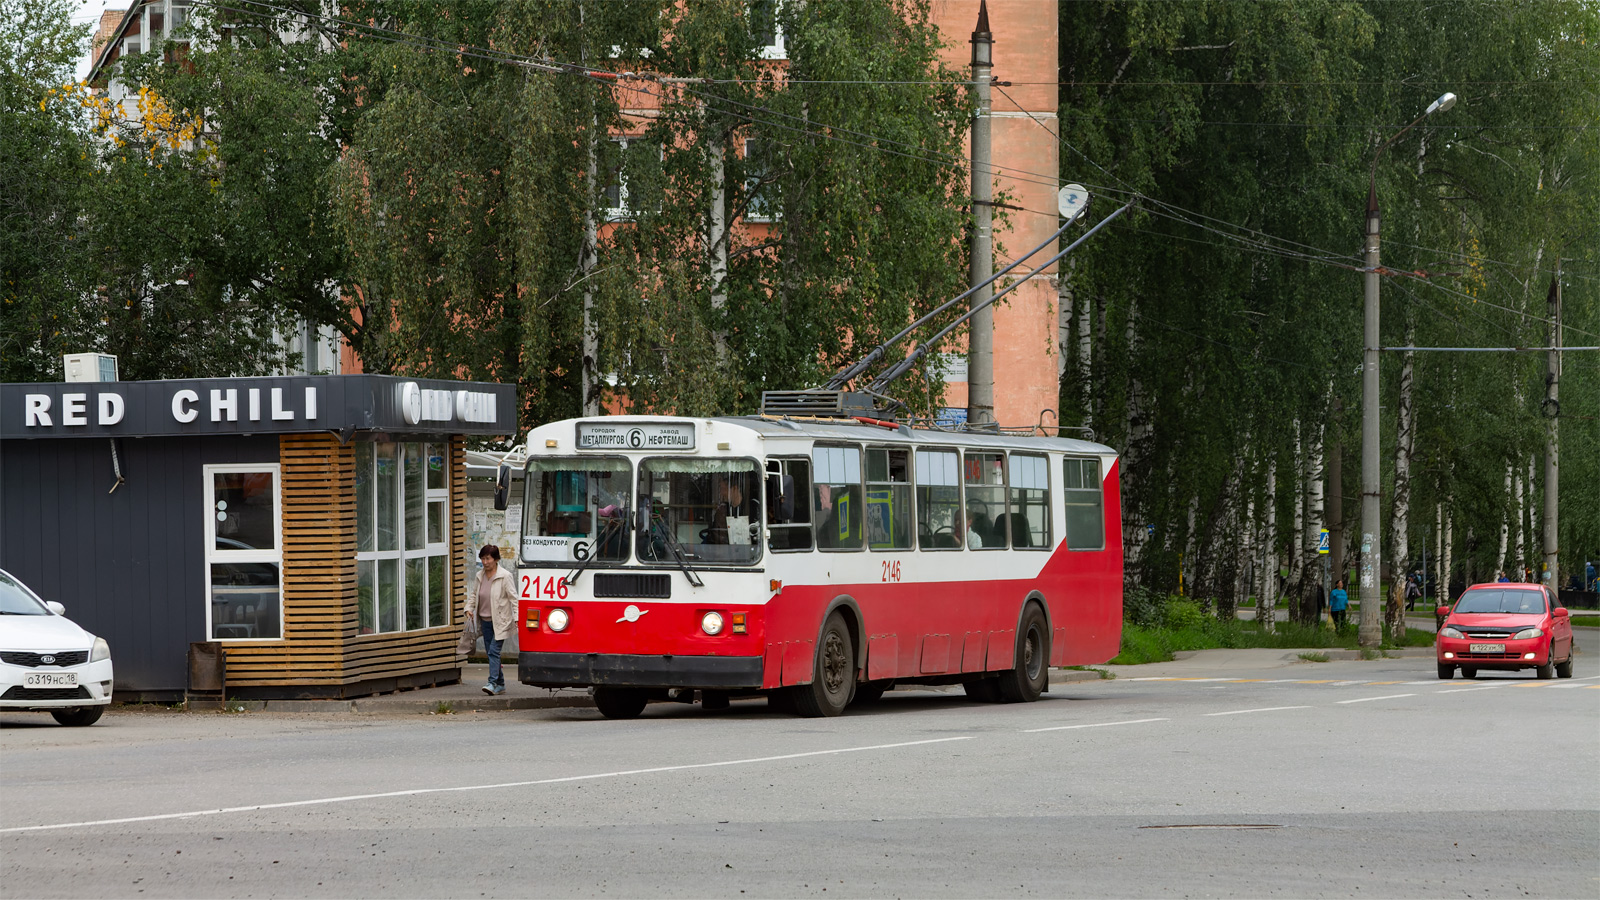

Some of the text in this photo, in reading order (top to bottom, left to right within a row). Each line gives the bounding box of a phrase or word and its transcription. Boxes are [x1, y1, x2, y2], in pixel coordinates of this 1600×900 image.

[25, 386, 318, 427] RED CHILI
[582, 430, 689, 448] МЕТАЛЛУРГОВ 6 НЕФТЕМАШ
[965, 458, 981, 480] 2146
[532, 539, 568, 547] КОНДУКТОРА
[573, 541, 590, 561] 6
[881, 560, 901, 583] 2146
[521, 575, 569, 600] 2146
